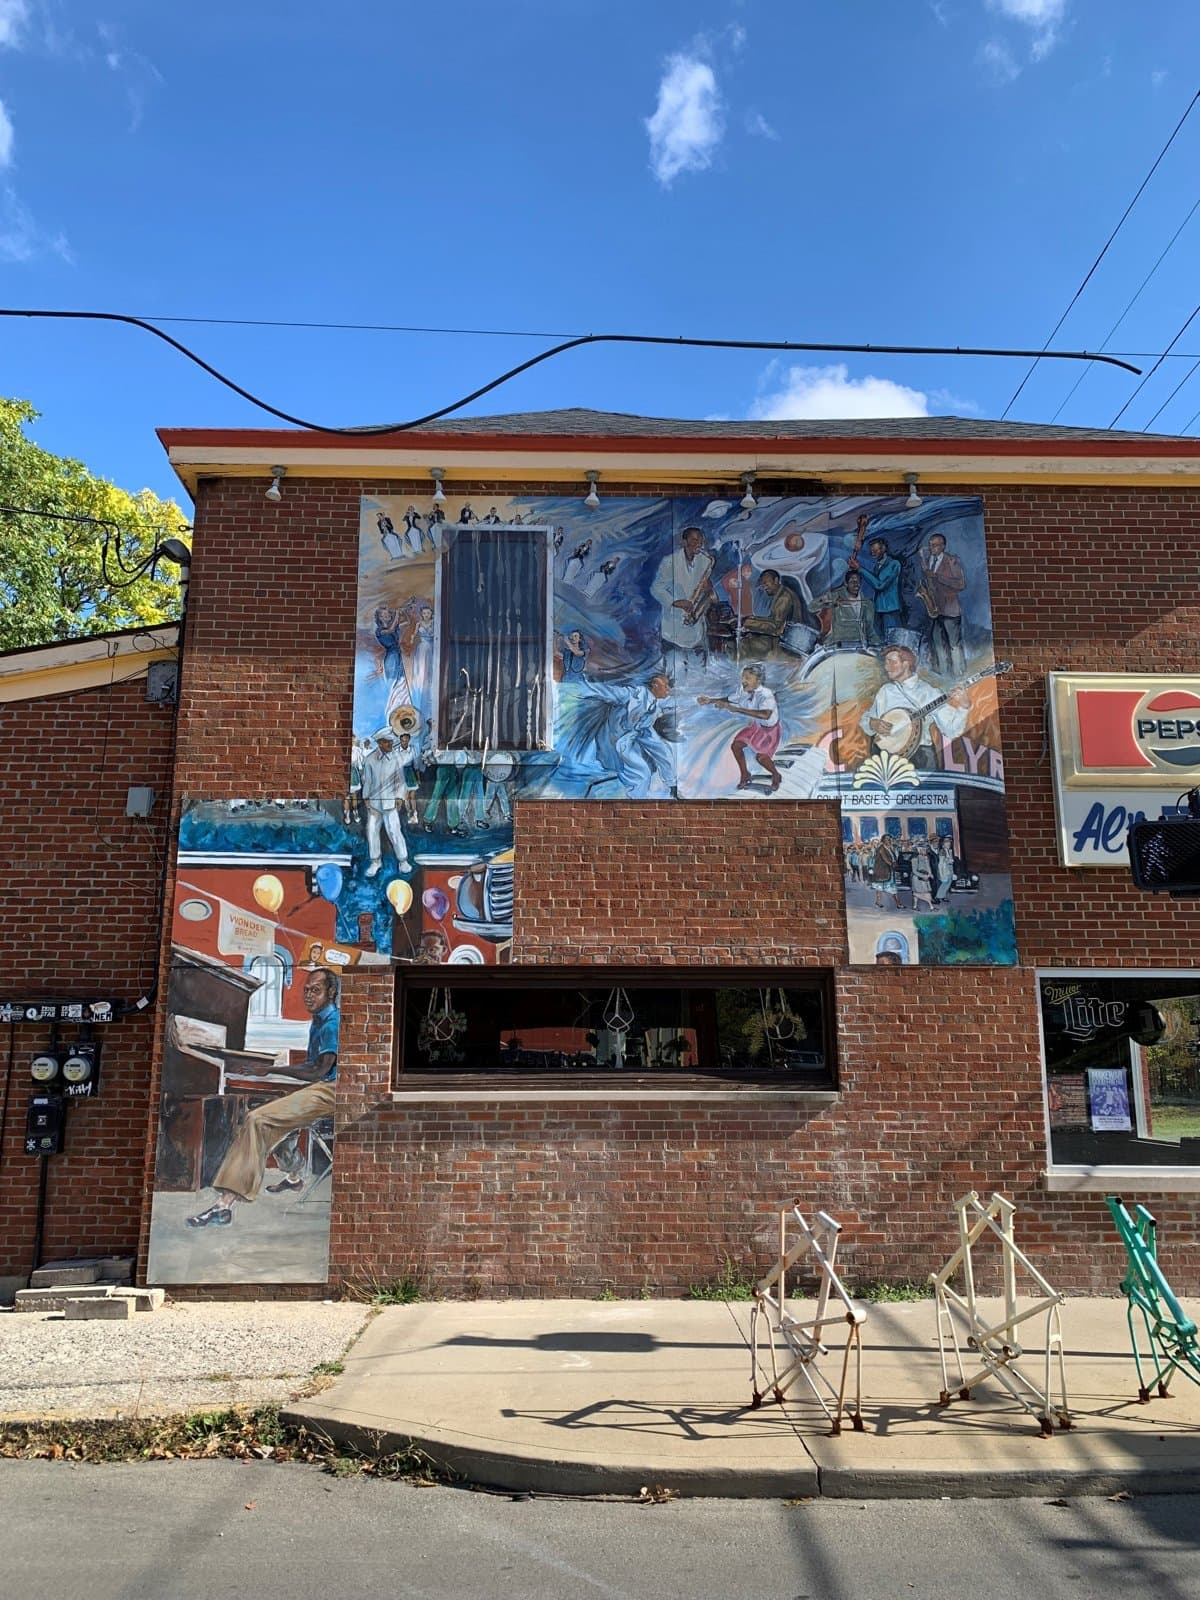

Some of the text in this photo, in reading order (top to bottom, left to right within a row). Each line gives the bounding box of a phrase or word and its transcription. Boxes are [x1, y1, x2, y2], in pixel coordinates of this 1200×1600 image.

[852, 794, 890, 806] BASIE'S
[896, 794, 948, 805] ORCHESTRA
[229, 913, 267, 934] WONDER
[234, 927, 258, 938] BREAD
[1044, 984, 1081, 1002] Miller
[1053, 997, 1125, 1037] Lite
